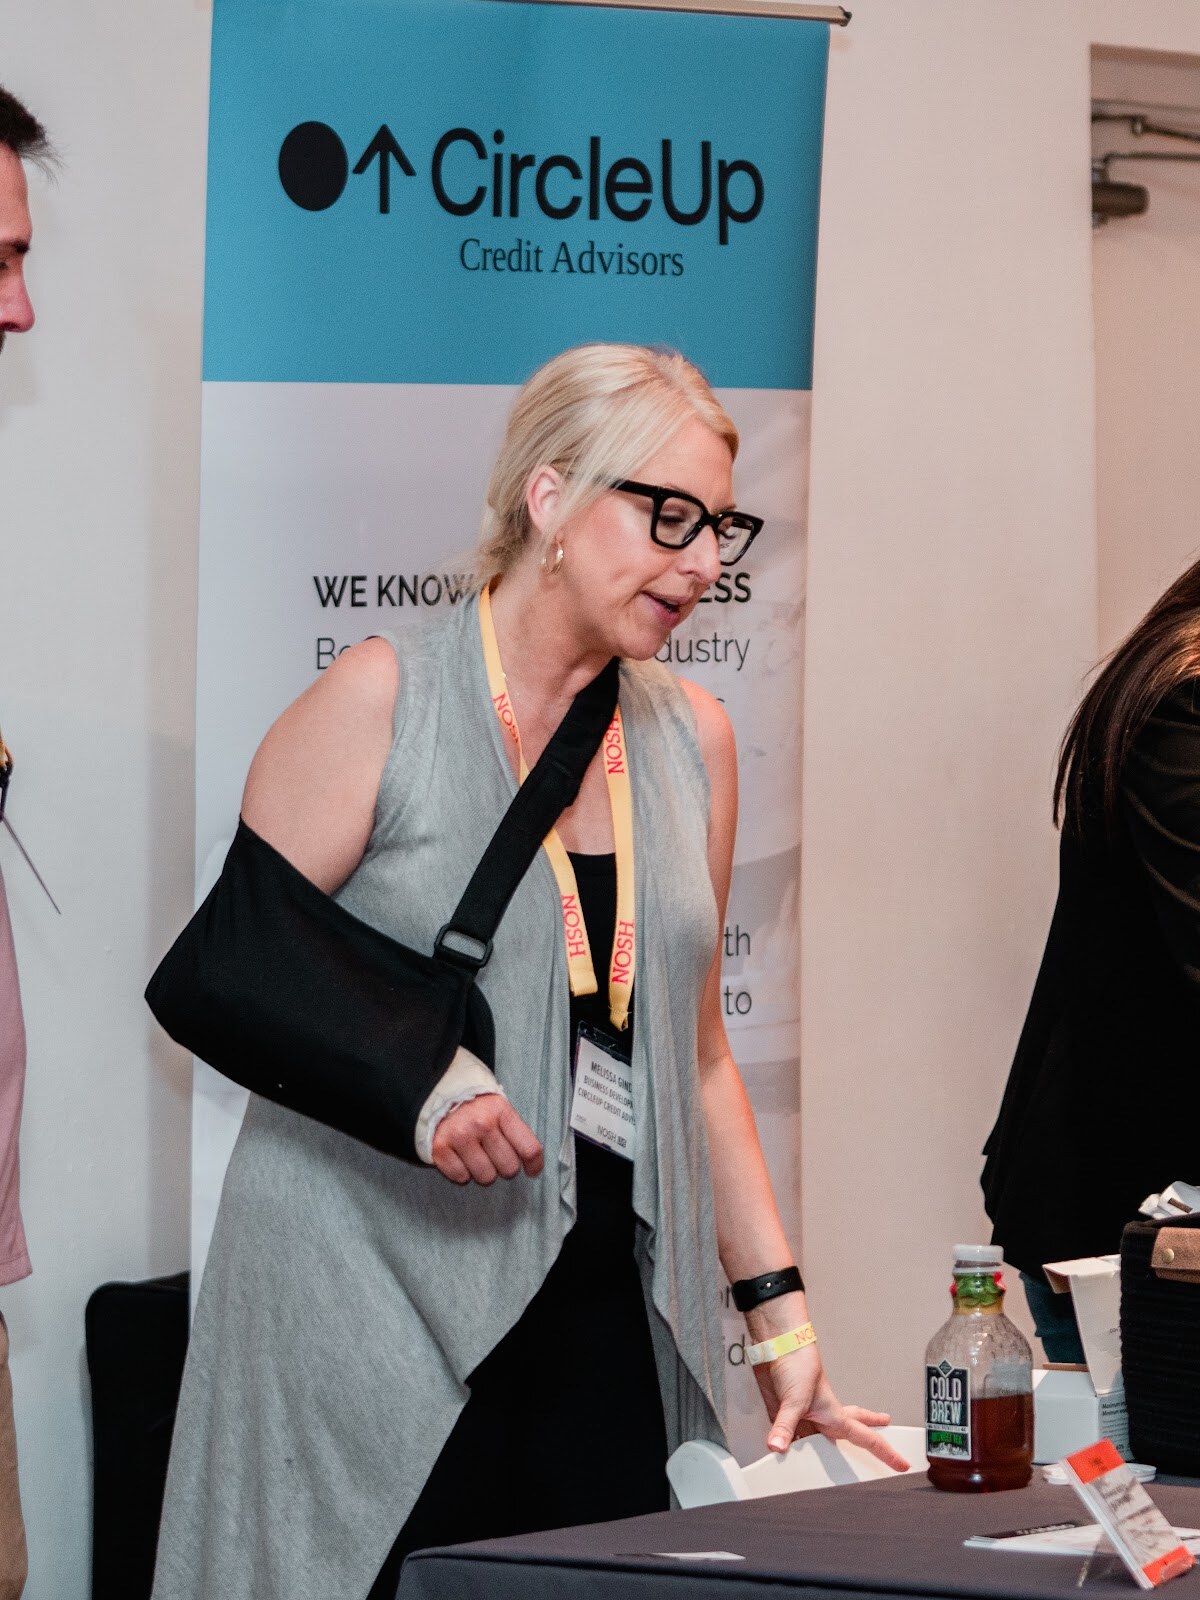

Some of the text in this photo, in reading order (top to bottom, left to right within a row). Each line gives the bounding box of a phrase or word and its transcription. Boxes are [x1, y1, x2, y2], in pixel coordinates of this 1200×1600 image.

[430, 127, 765, 245] CircleUp
[459, 237, 685, 277] Credit Advisors
[313, 574, 476, 608] WE KNOW
[561, 893, 587, 958] NOSH
[611, 919, 635, 985] NOSH
[723, 984, 753, 1016] to
[929, 1375, 963, 1402] COLD
[930, 1399, 963, 1426] BREW
